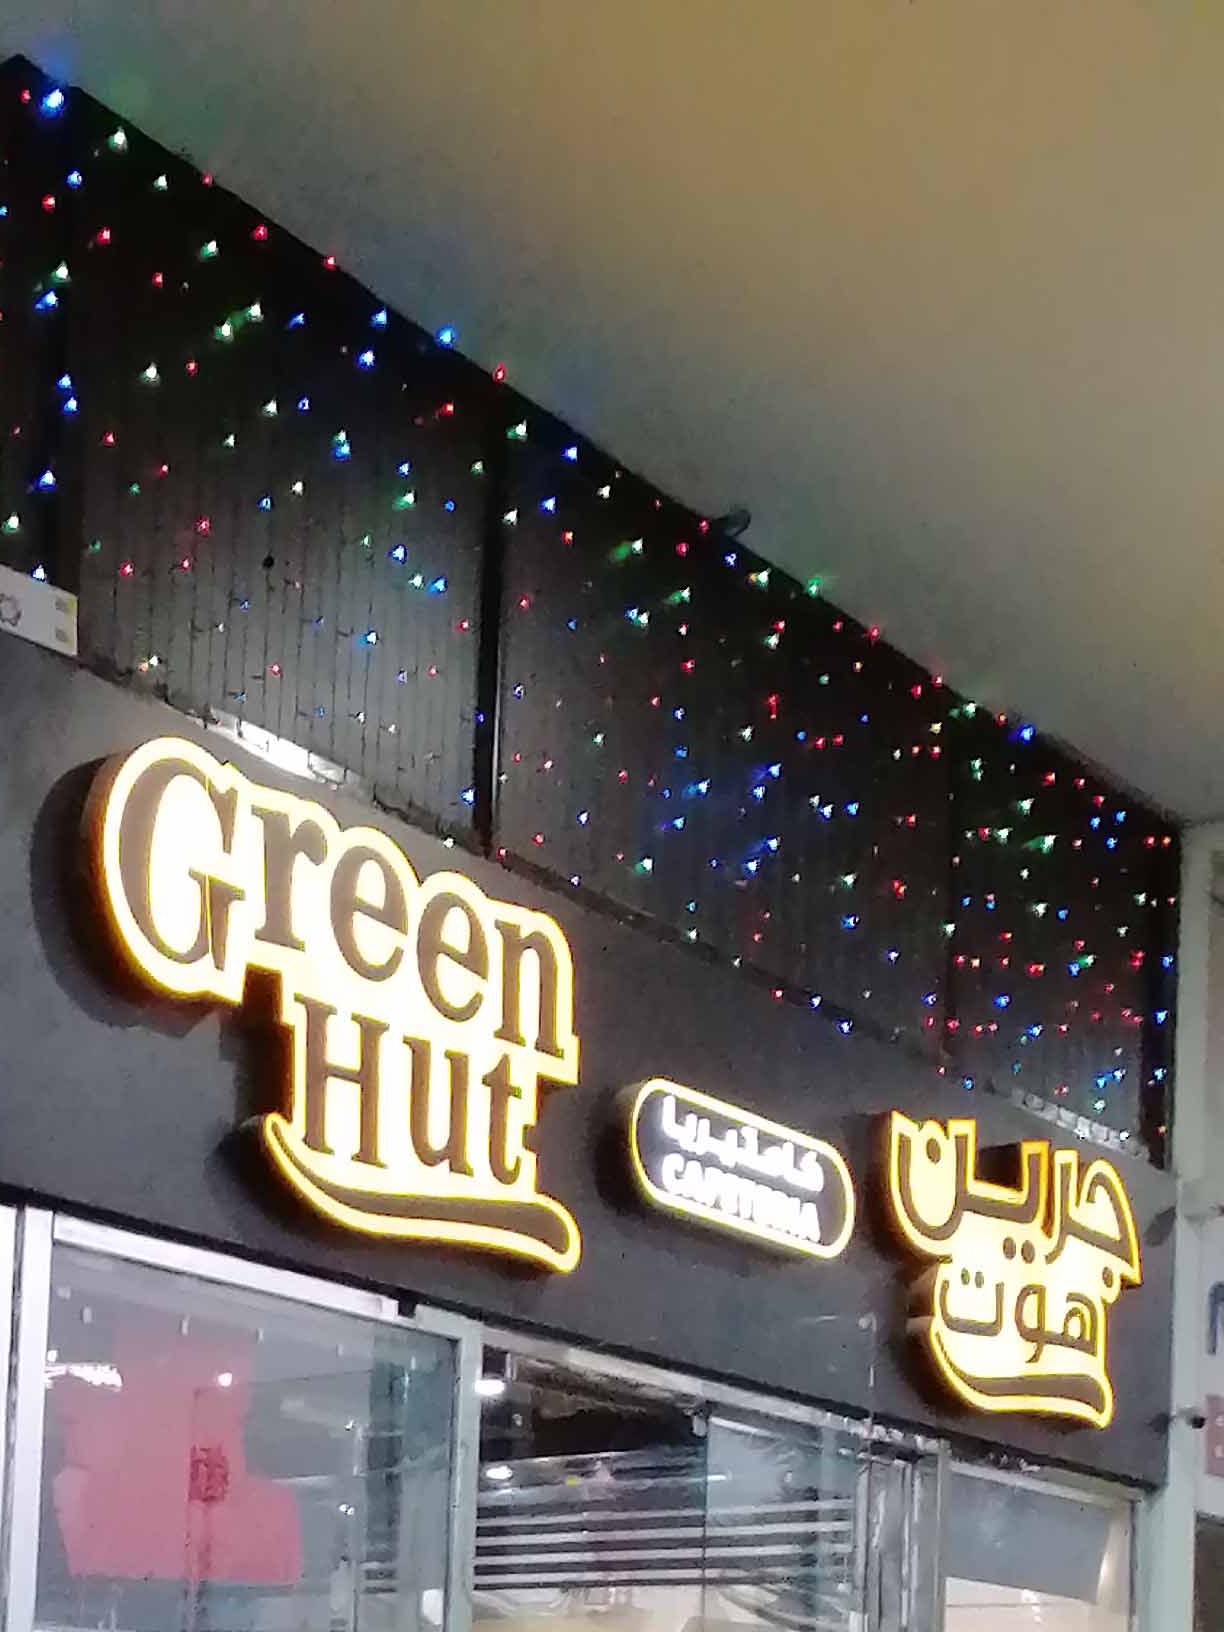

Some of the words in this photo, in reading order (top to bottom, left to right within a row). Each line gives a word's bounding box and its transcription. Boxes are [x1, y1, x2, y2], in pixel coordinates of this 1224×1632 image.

[118, 757, 565, 1060] Green
[293, 992, 522, 1186] Hut
[898, 1131, 1132, 1289] جرين
[939, 1267, 1097, 1364] هوت
